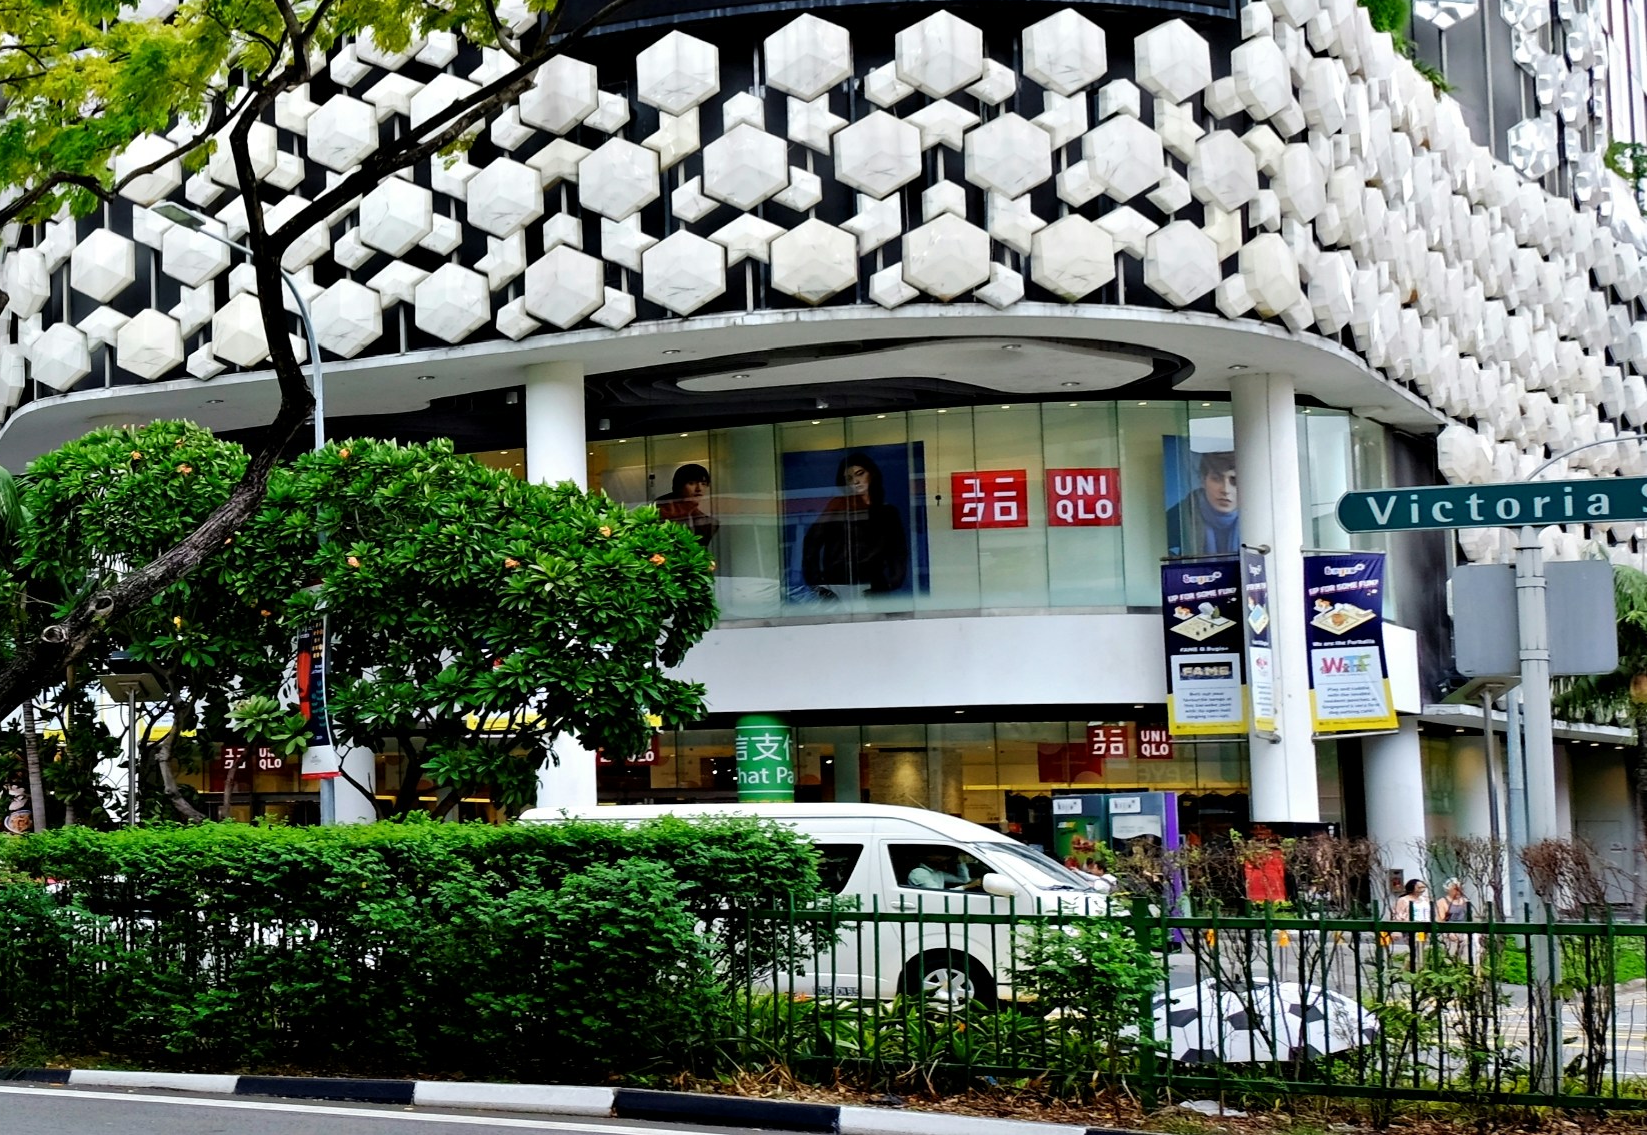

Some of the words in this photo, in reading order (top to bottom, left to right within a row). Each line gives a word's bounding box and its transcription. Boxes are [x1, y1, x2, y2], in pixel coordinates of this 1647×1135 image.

[1054, 475, 1108, 495] UNI
[1056, 499, 1113, 523] QLO
[1367, 486, 1610, 525] Victoria
[1337, 583, 1357, 592] SOME
[1180, 593, 1195, 601] FOR
[1196, 590, 1216, 599] SOME
[1141, 731, 1165, 742] UNI
[1141, 744, 1169, 756] QLO
[259, 759, 281, 770] QLO
[737, 767, 769, 784] hat
